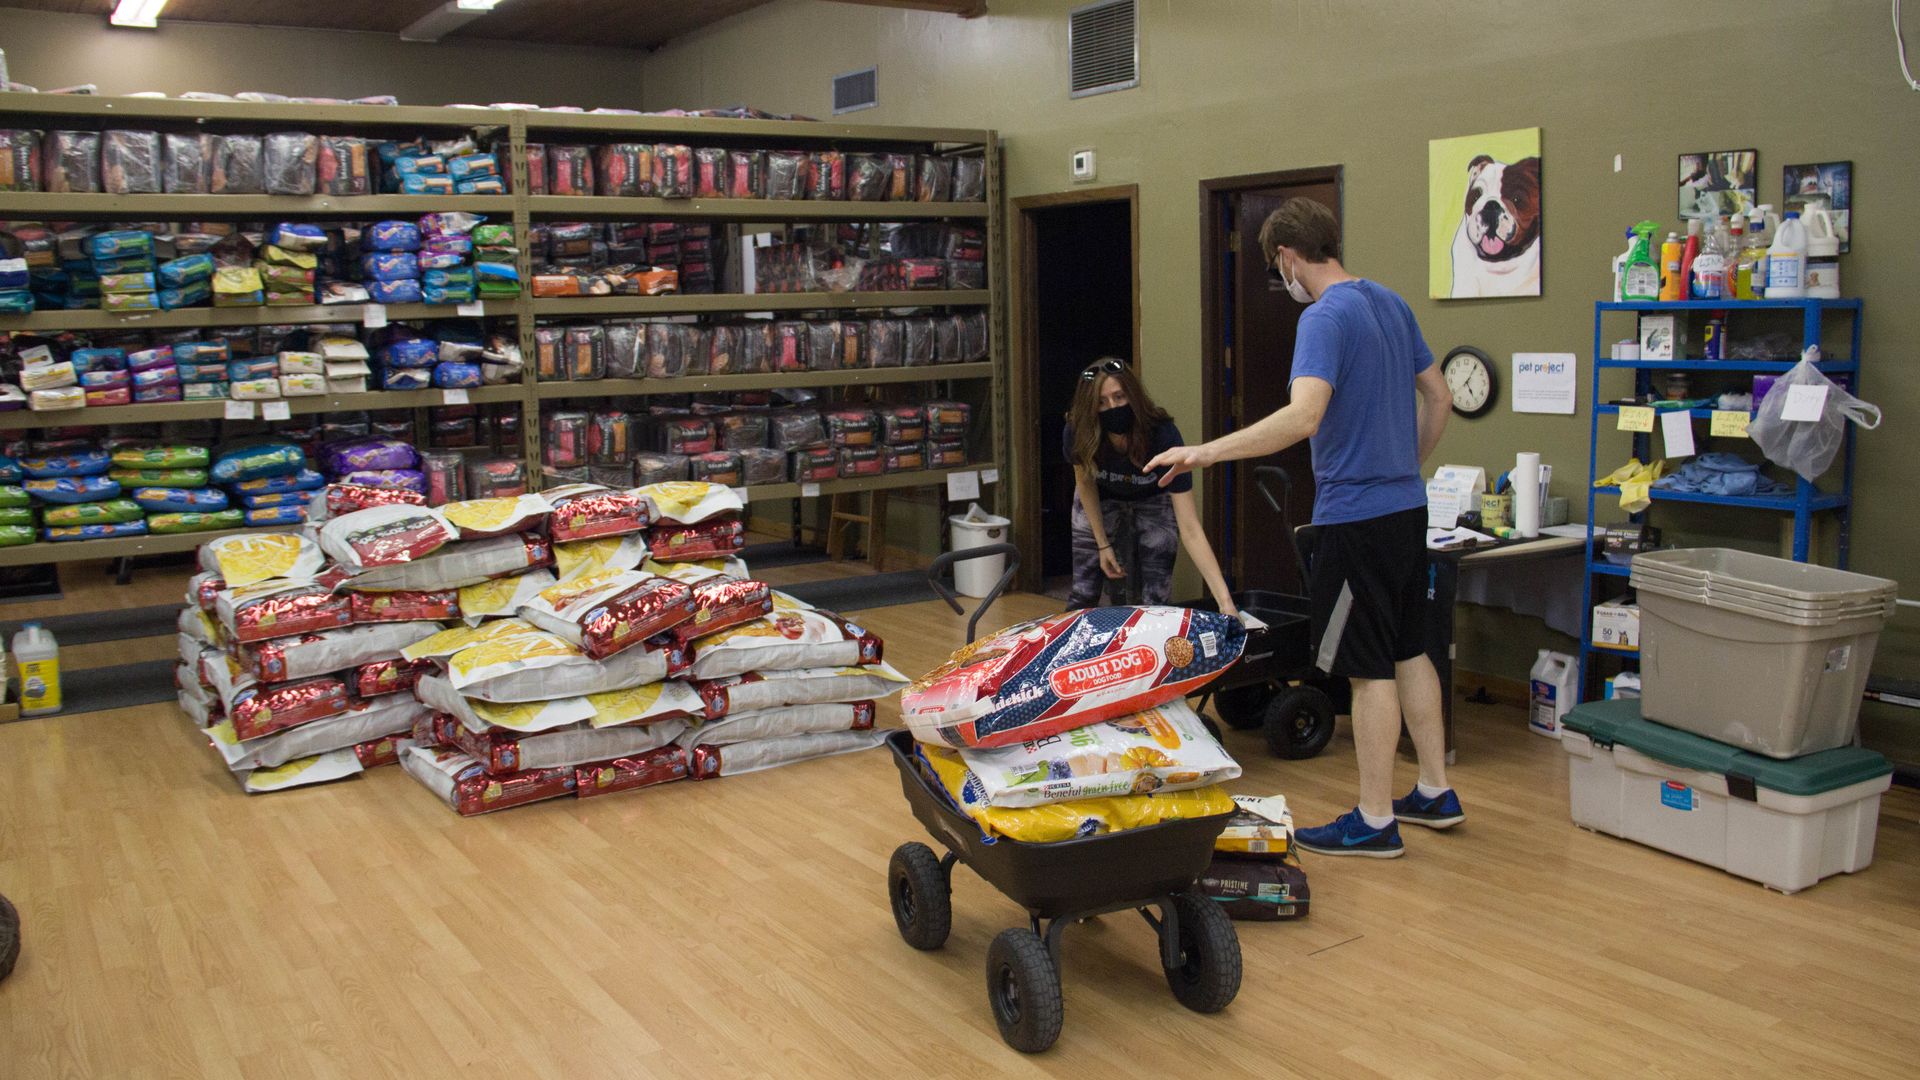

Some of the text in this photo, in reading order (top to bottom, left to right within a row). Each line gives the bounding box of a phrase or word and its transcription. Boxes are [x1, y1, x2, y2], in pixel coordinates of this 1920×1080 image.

[1519, 362, 1564, 374] pet project
[1602, 628, 1613, 636] 50
[1069, 652, 1142, 684] ADULT DOG
[1092, 673, 1122, 686] DOG FOOD
[1043, 786, 1081, 798] Beneful
[1220, 879, 1249, 890] PRISTINE
